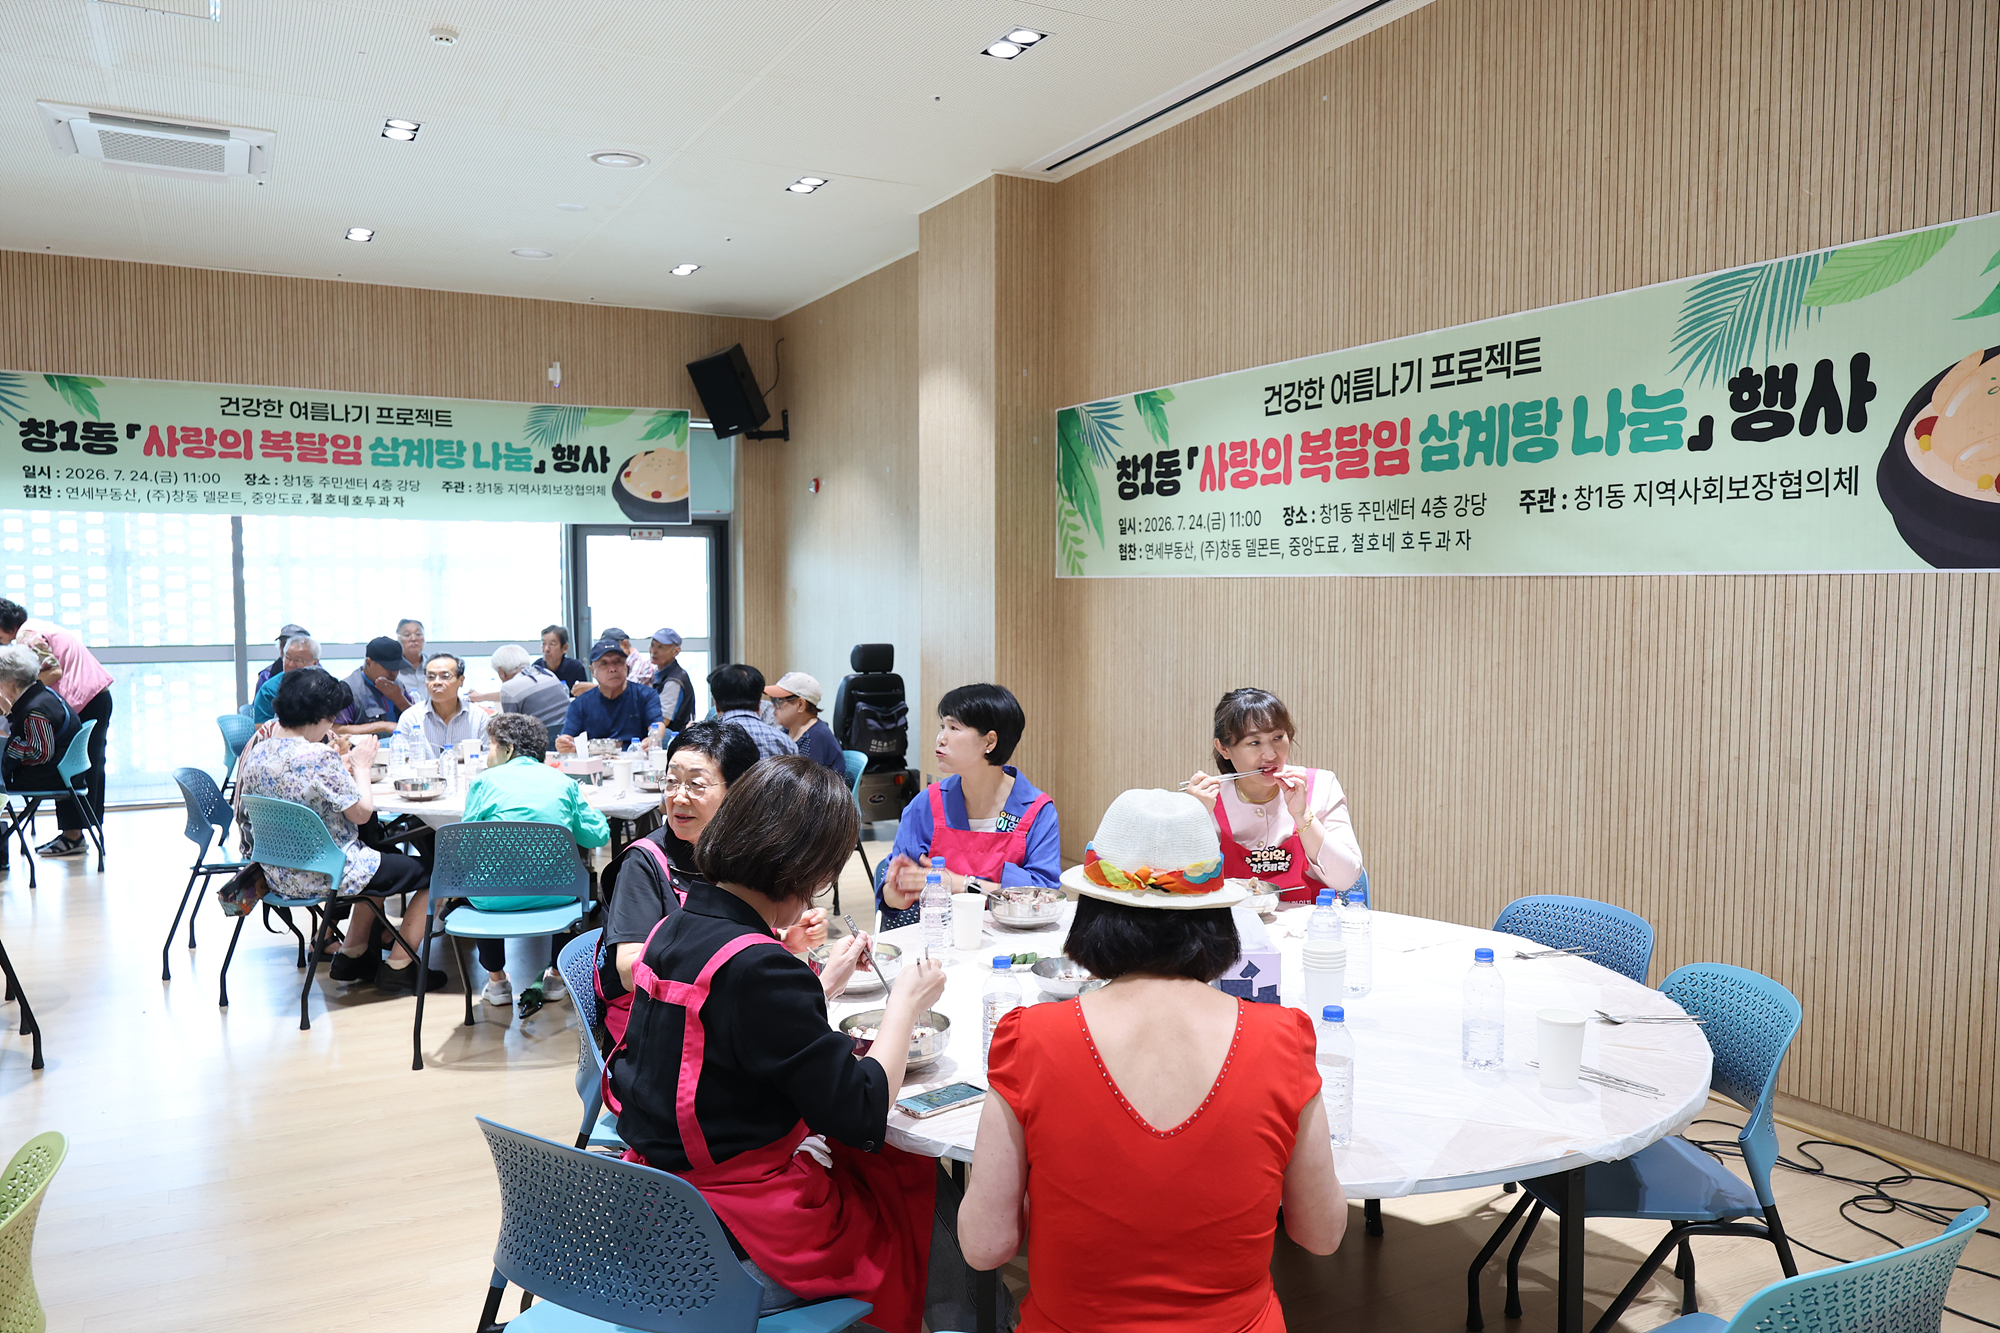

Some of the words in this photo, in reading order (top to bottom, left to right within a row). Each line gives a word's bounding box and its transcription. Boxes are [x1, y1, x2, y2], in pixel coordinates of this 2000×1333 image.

[1264, 376, 1325, 417] 건강한
[1330, 358, 1422, 405] 여름나기
[1430, 336, 1542, 390] 프로젝트
[219, 396, 284, 419] 건강한
[289, 401, 370, 424] 여름나기
[375, 406, 453, 428] 프로젝트
[1116, 449, 1182, 500] 창1동
[1298, 417, 1411, 483] 복달임
[1418, 396, 1563, 473] 삼계탕
[1728, 352, 1877, 442] 행사
[19, 417, 119, 455] 창1동
[259, 429, 362, 466] 복달임
[368, 436, 467, 469] 삼계탕
[551, 443, 611, 474] 행사
[65, 467, 109, 481] 2026.
[114, 469, 125, 481] 7.
[130, 470, 178, 485] 24.(금)
[183, 472, 221, 484] 11:00
[282, 474, 314, 488] 창1동
[318, 476, 368, 490] 주민센터
[372, 478, 393, 492] 4층
[397, 479, 421, 493] 강당
[1573, 483, 1626, 511] 창1동
[1633, 464, 1860, 507] 지역사회보장협의체
[65, 486, 141, 503] 연세부동산,
[146, 489, 199, 504] (주)창동
[475, 482, 504, 495] 창1동
[507, 483, 606, 497] 지역사회보장협의체
[1319, 502, 1354, 525] 창1동
[1357, 497, 1415, 522] 주민센터
[1421, 495, 1448, 519] 4층
[1453, 492, 1487, 518] 강당
[1144, 516, 1175, 533] 2026.
[1177, 515, 1186, 531] 7.
[1189, 511, 1226, 533] 24.(금)
[1229, 510, 1262, 528] 11:00
[1144, 540, 1197, 561] 연세부동산,
[1200, 538, 1242, 561] (주)창동
[1251, 849, 1286, 862] 구의원
[1249, 861, 1290, 874] 강혜란
